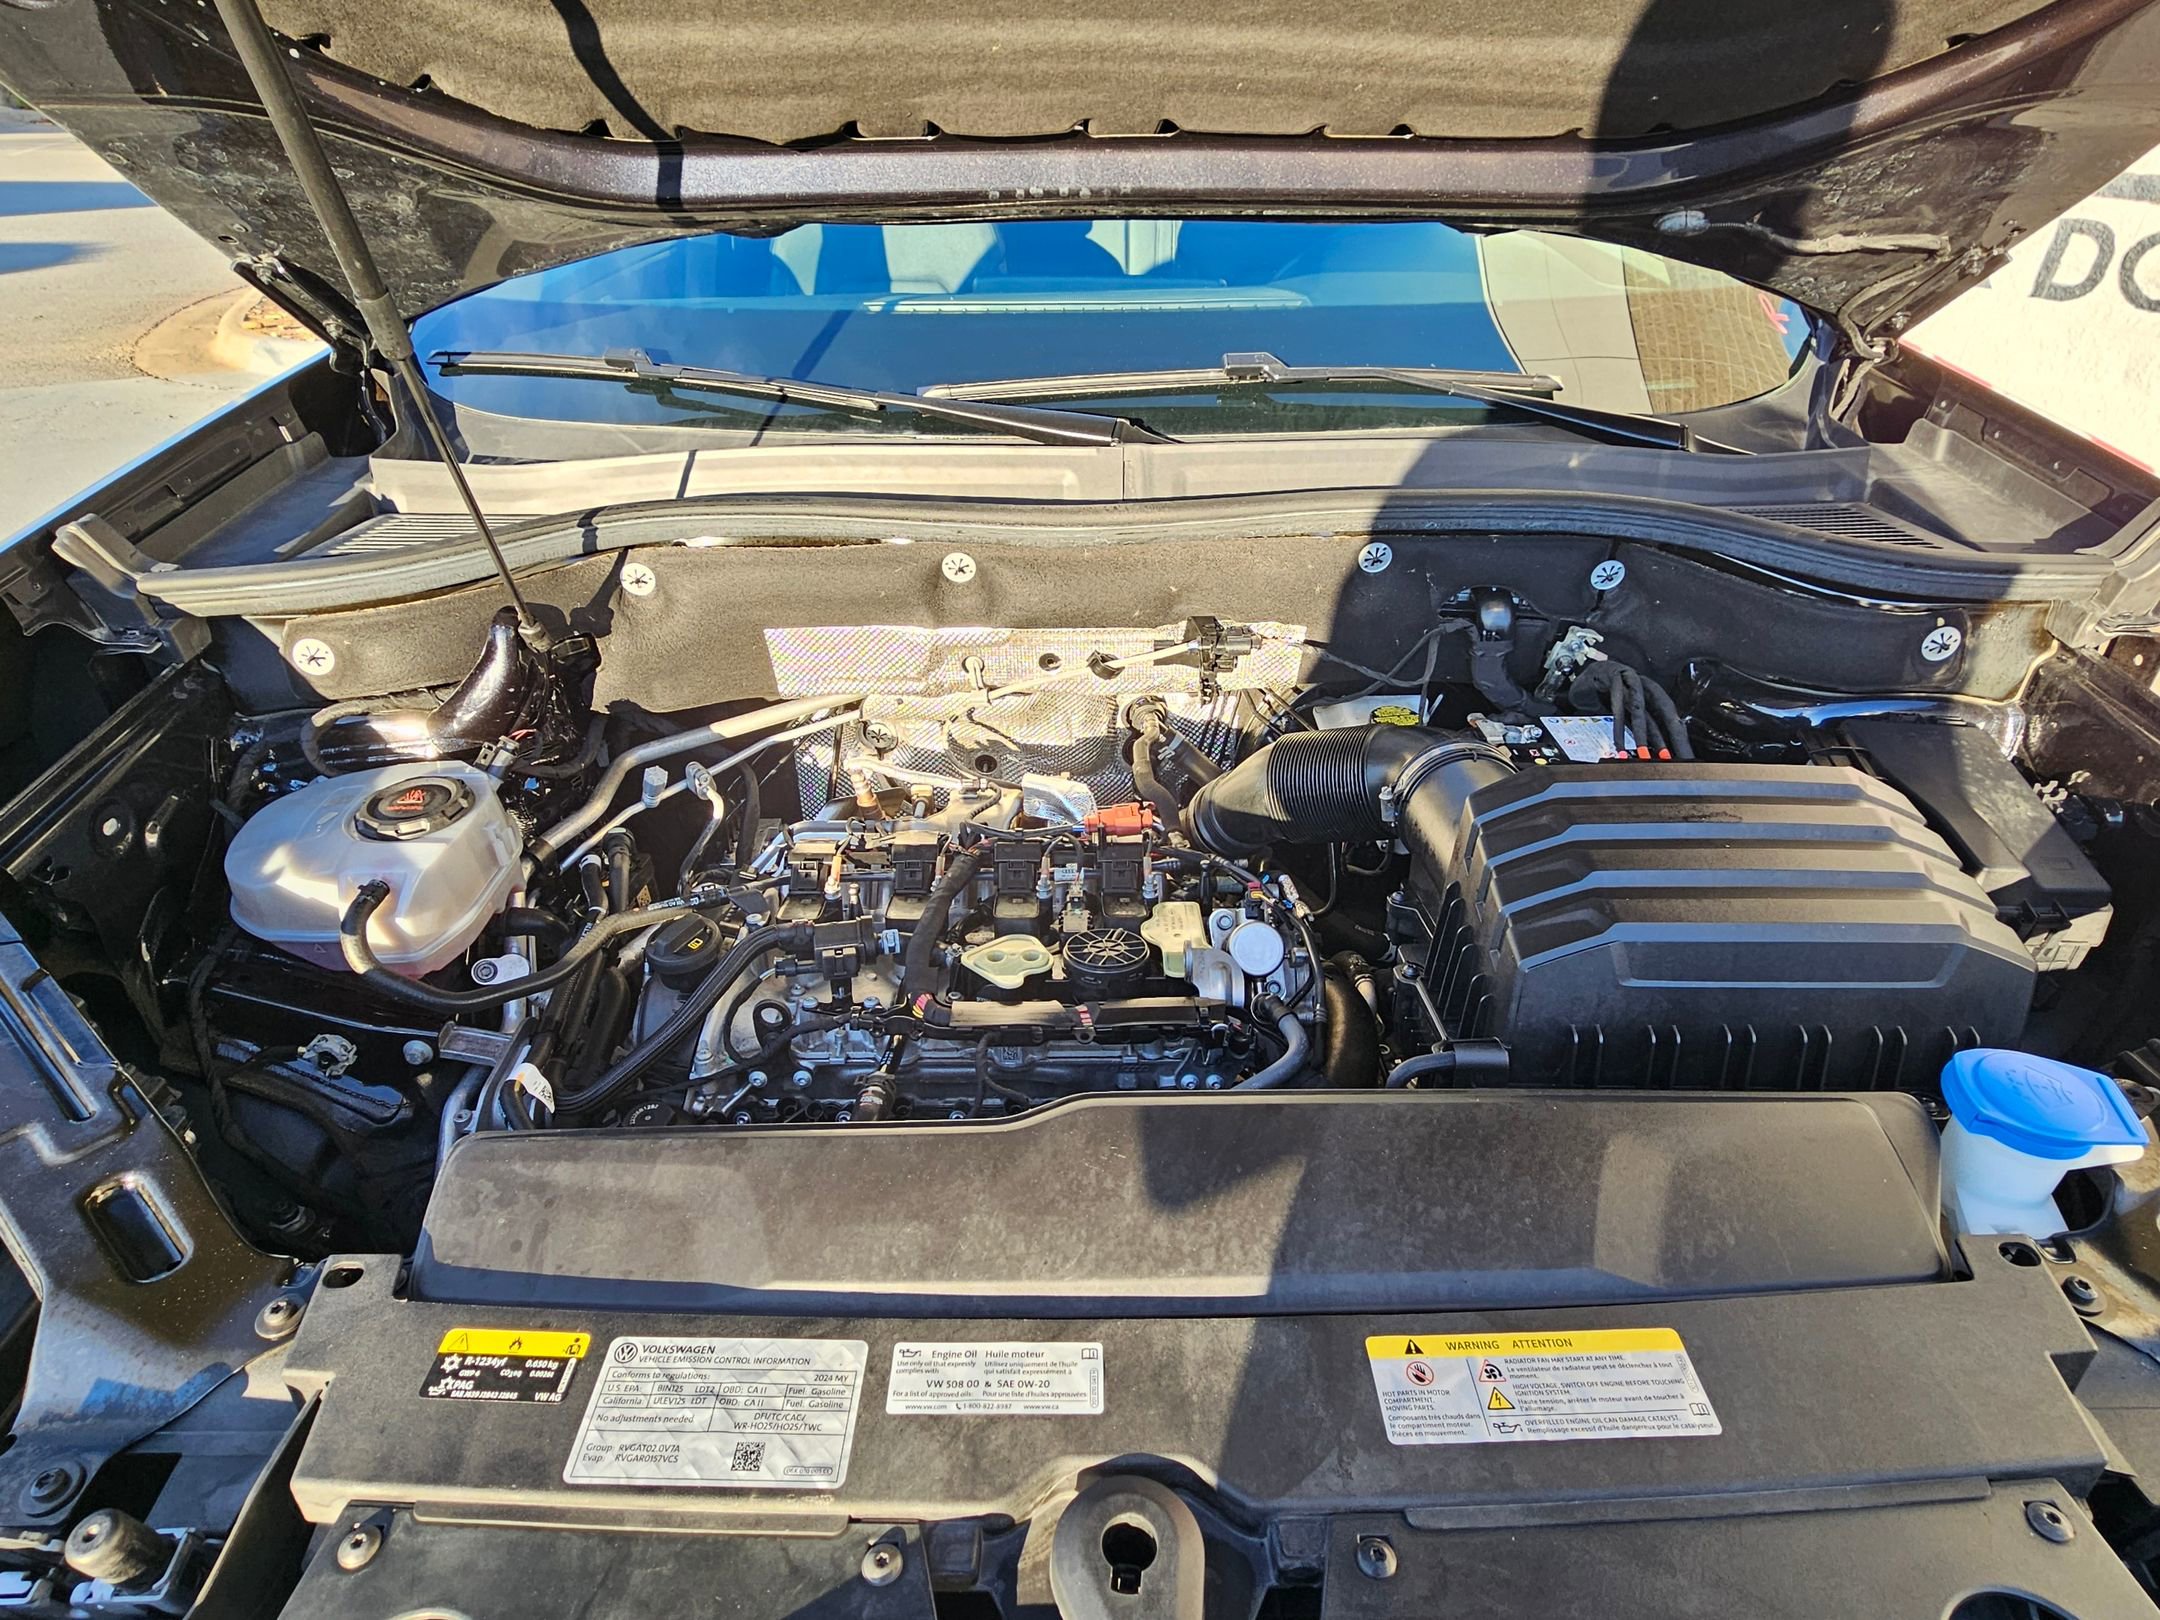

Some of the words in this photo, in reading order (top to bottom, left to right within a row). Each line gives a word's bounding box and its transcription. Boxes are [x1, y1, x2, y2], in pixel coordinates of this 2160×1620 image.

[1445, 1340, 1500, 1351] WARNING
[1512, 1338, 1574, 1349] ATTENTION
[642, 1345, 716, 1354] VOLKSWAGEN
[985, 1350, 1009, 1358] Huile
[931, 1350, 963, 1360] Engine
[964, 1350, 977, 1358] Oil
[464, 1356, 508, 1369] R-1234yf
[673, 1356, 713, 1364] EMISSION
[714, 1356, 750, 1365] CONTROL
[753, 1357, 811, 1366] INFORMATION
[909, 1360, 923, 1368] only
[947, 1361, 976, 1369] expressly
[1009, 1361, 1048, 1369] uniquement
[612, 1370, 650, 1379] Conforms
[652, 1371, 661, 1379] to
[662, 1371, 711, 1381] regulations:
[983, 1368, 995, 1376] qui
[813, 1374, 833, 1382] 2024
[835, 1374, 849, 1383] MY
[1651, 1378, 1685, 1386] TOUCHING
[926, 1379, 944, 1388] VW
[946, 1380, 964, 1388] 508
[966, 1380, 980, 1388] 00
[996, 1380, 1015, 1388] SAE
[1017, 1380, 1051, 1388] 0W-20
[657, 1384, 684, 1393] BIN125
[694, 1385, 716, 1394] LDT2
[811, 1388, 847, 1396] Gasoline
[929, 1390, 960, 1398] approved
[534, 1392, 549, 1401] VW
[549, 1393, 562, 1402] AG
[653, 1397, 686, 1406] ULEV125
[690, 1397, 707, 1405] LDT
[808, 1400, 844, 1409] Gasoline
[596, 1413, 609, 1422] No
[610, 1414, 662, 1425] adjustments
[1388, 1414, 1428, 1422] Composants
[1465, 1412, 1481, 1420] dans
[1397, 1422, 1446, 1430] compartiment
[1527, 1427, 1570, 1435] Remplissage
